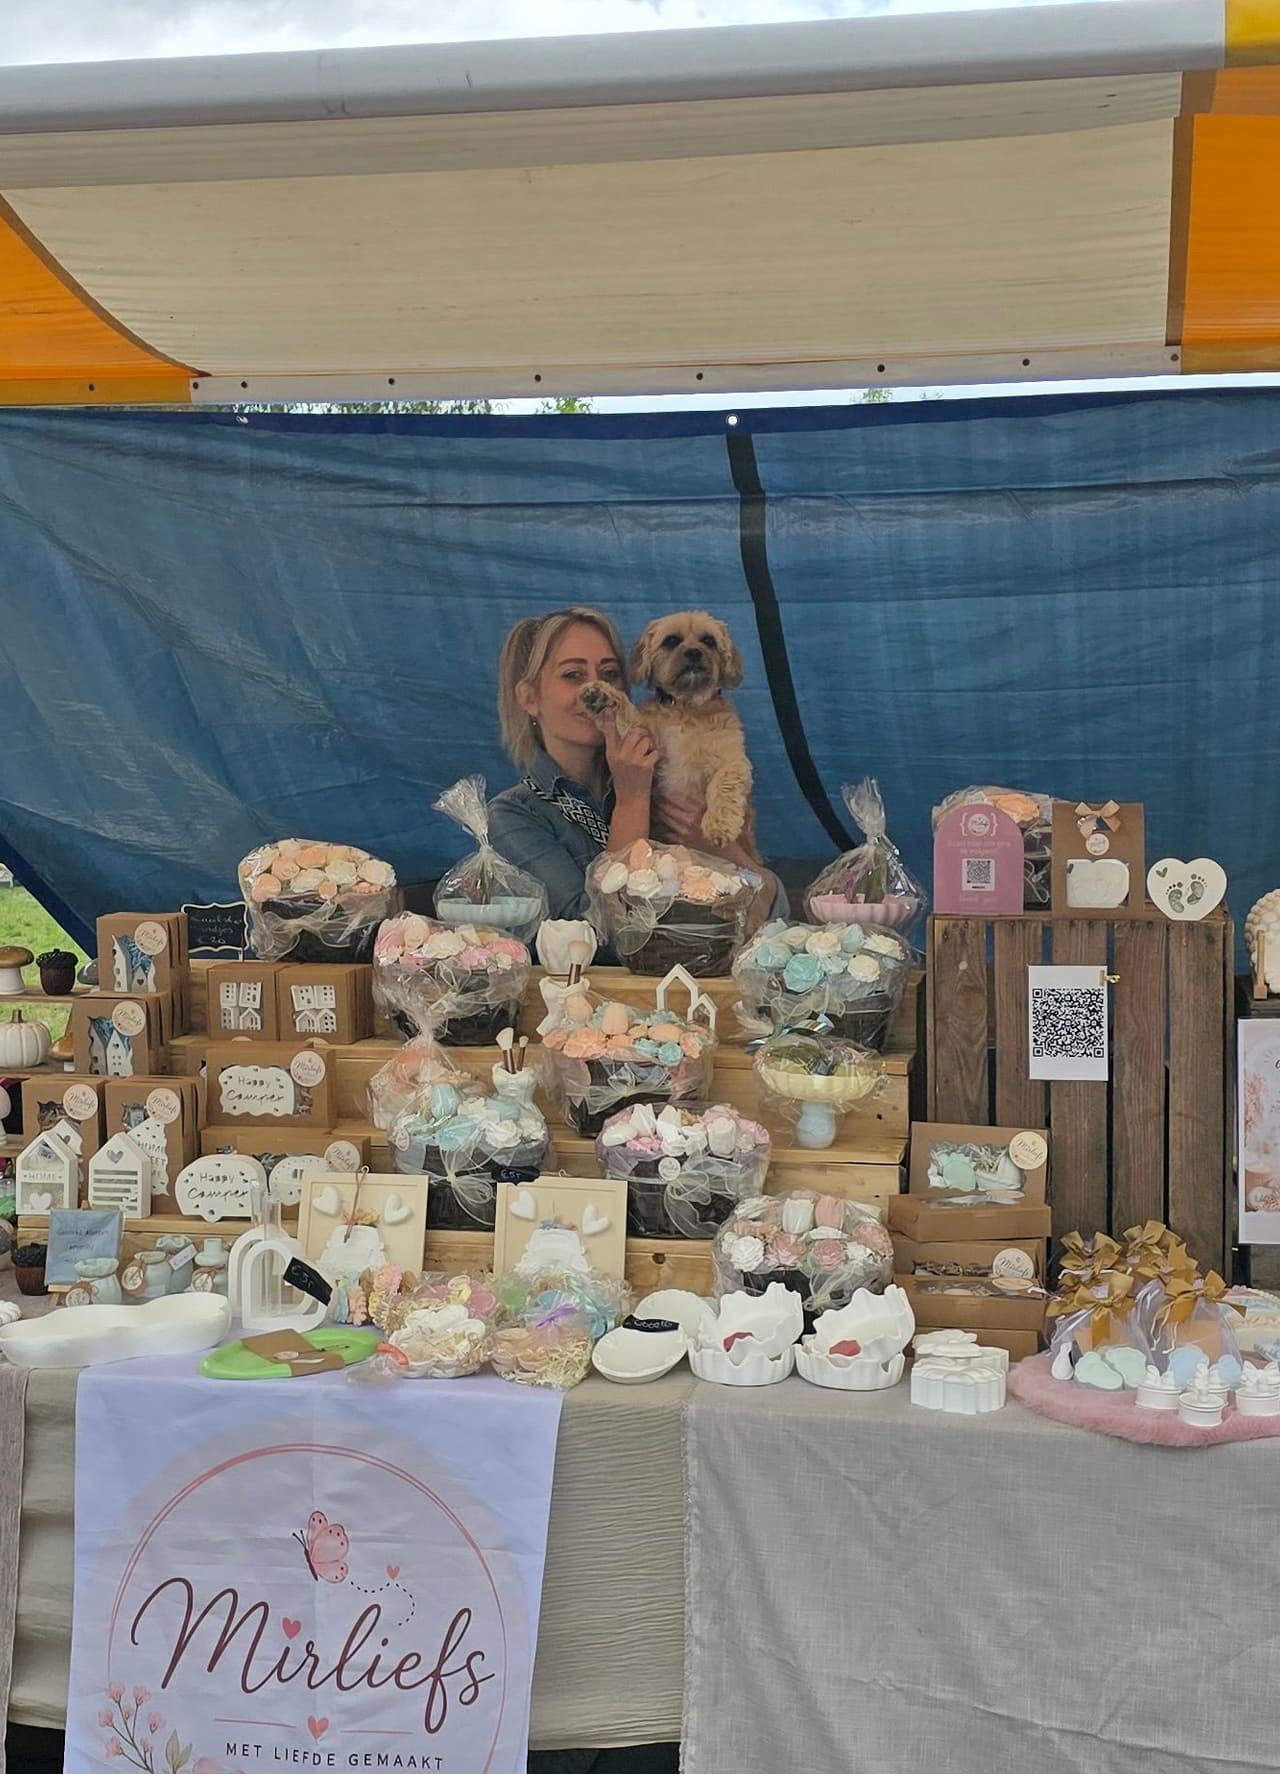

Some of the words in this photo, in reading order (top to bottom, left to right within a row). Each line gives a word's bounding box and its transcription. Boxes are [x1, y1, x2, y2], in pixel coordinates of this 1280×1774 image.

[131, 1577, 495, 1734] Mirliefs
[226, 1741, 262, 1759] MET
[274, 1747, 336, 1767] LIEFDE
[348, 1753, 444, 1771] GEMAAKT
